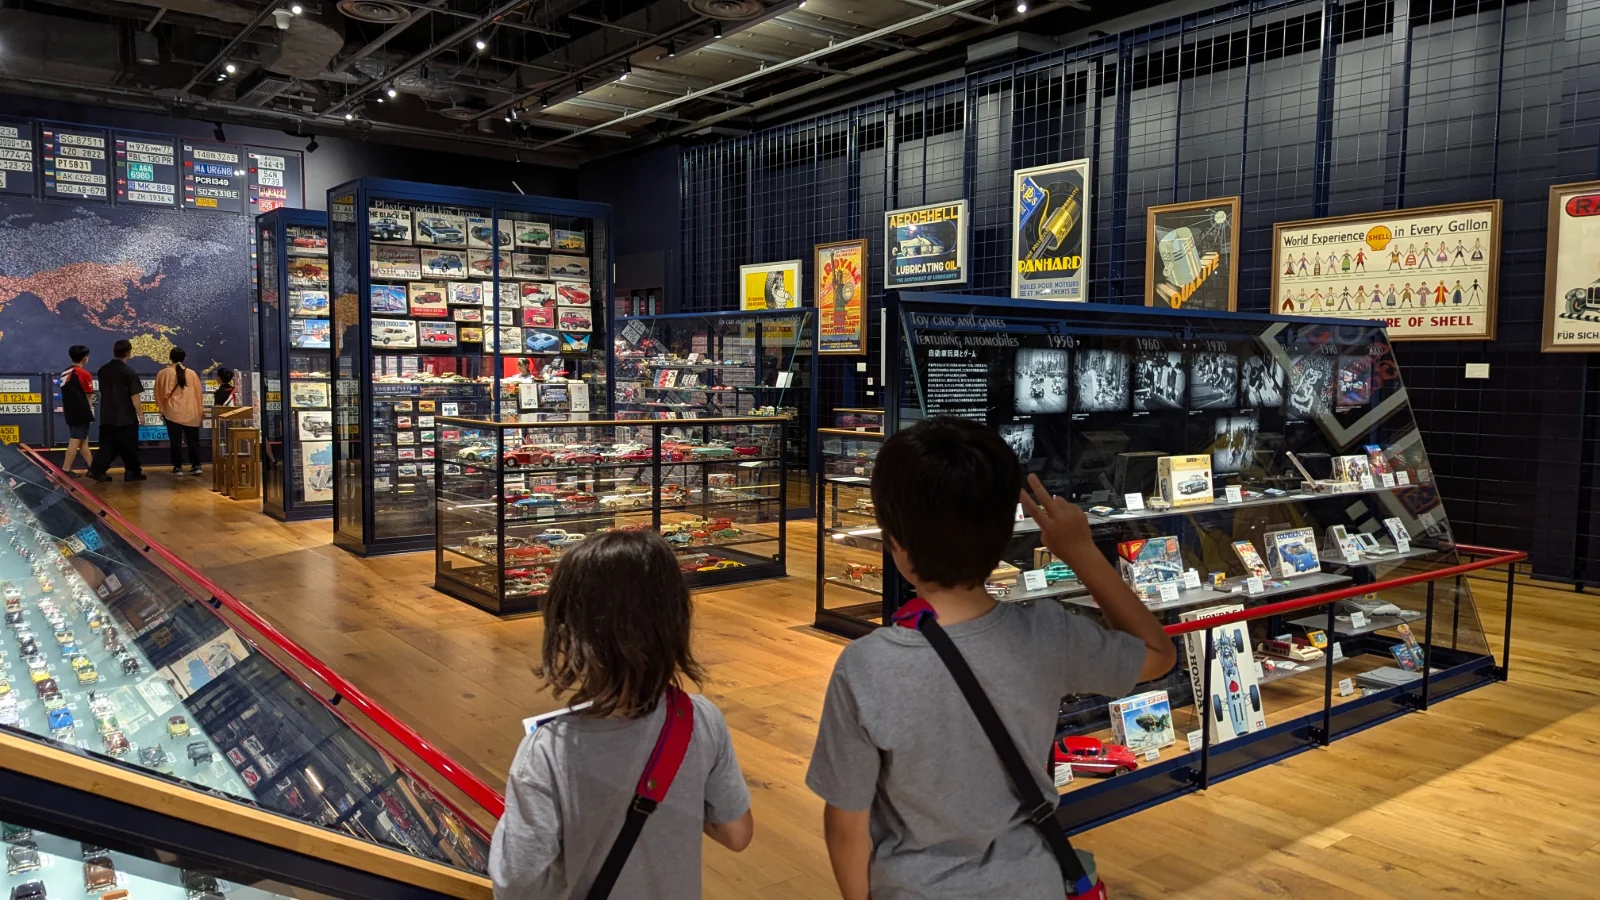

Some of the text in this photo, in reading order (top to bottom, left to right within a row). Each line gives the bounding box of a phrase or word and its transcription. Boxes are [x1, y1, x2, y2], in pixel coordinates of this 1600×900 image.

[380, 211, 399, 219] BLACK
[889, 205, 960, 228] AEROSHELL
[1284, 218, 1489, 247] World Experience in Every Gallon
[1368, 233, 1390, 242] SHELL
[896, 260, 958, 275] LUBRICATING OIL
[1018, 256, 1082, 273] PANHARD
[1055, 280, 1079, 288] MOTEURS
[1408, 316, 1425, 327] OF
[1430, 315, 1474, 327] SHELL
[1048, 335, 1074, 348] 1950
[1557, 331, 1575, 340] FÜR
[1137, 338, 1160, 350] 1960
[1206, 340, 1228, 352] 1970
[1321, 344, 1338, 355] 1990
[1367, 345, 1384, 356] 2000
[13, 405, 30, 413] 5555
